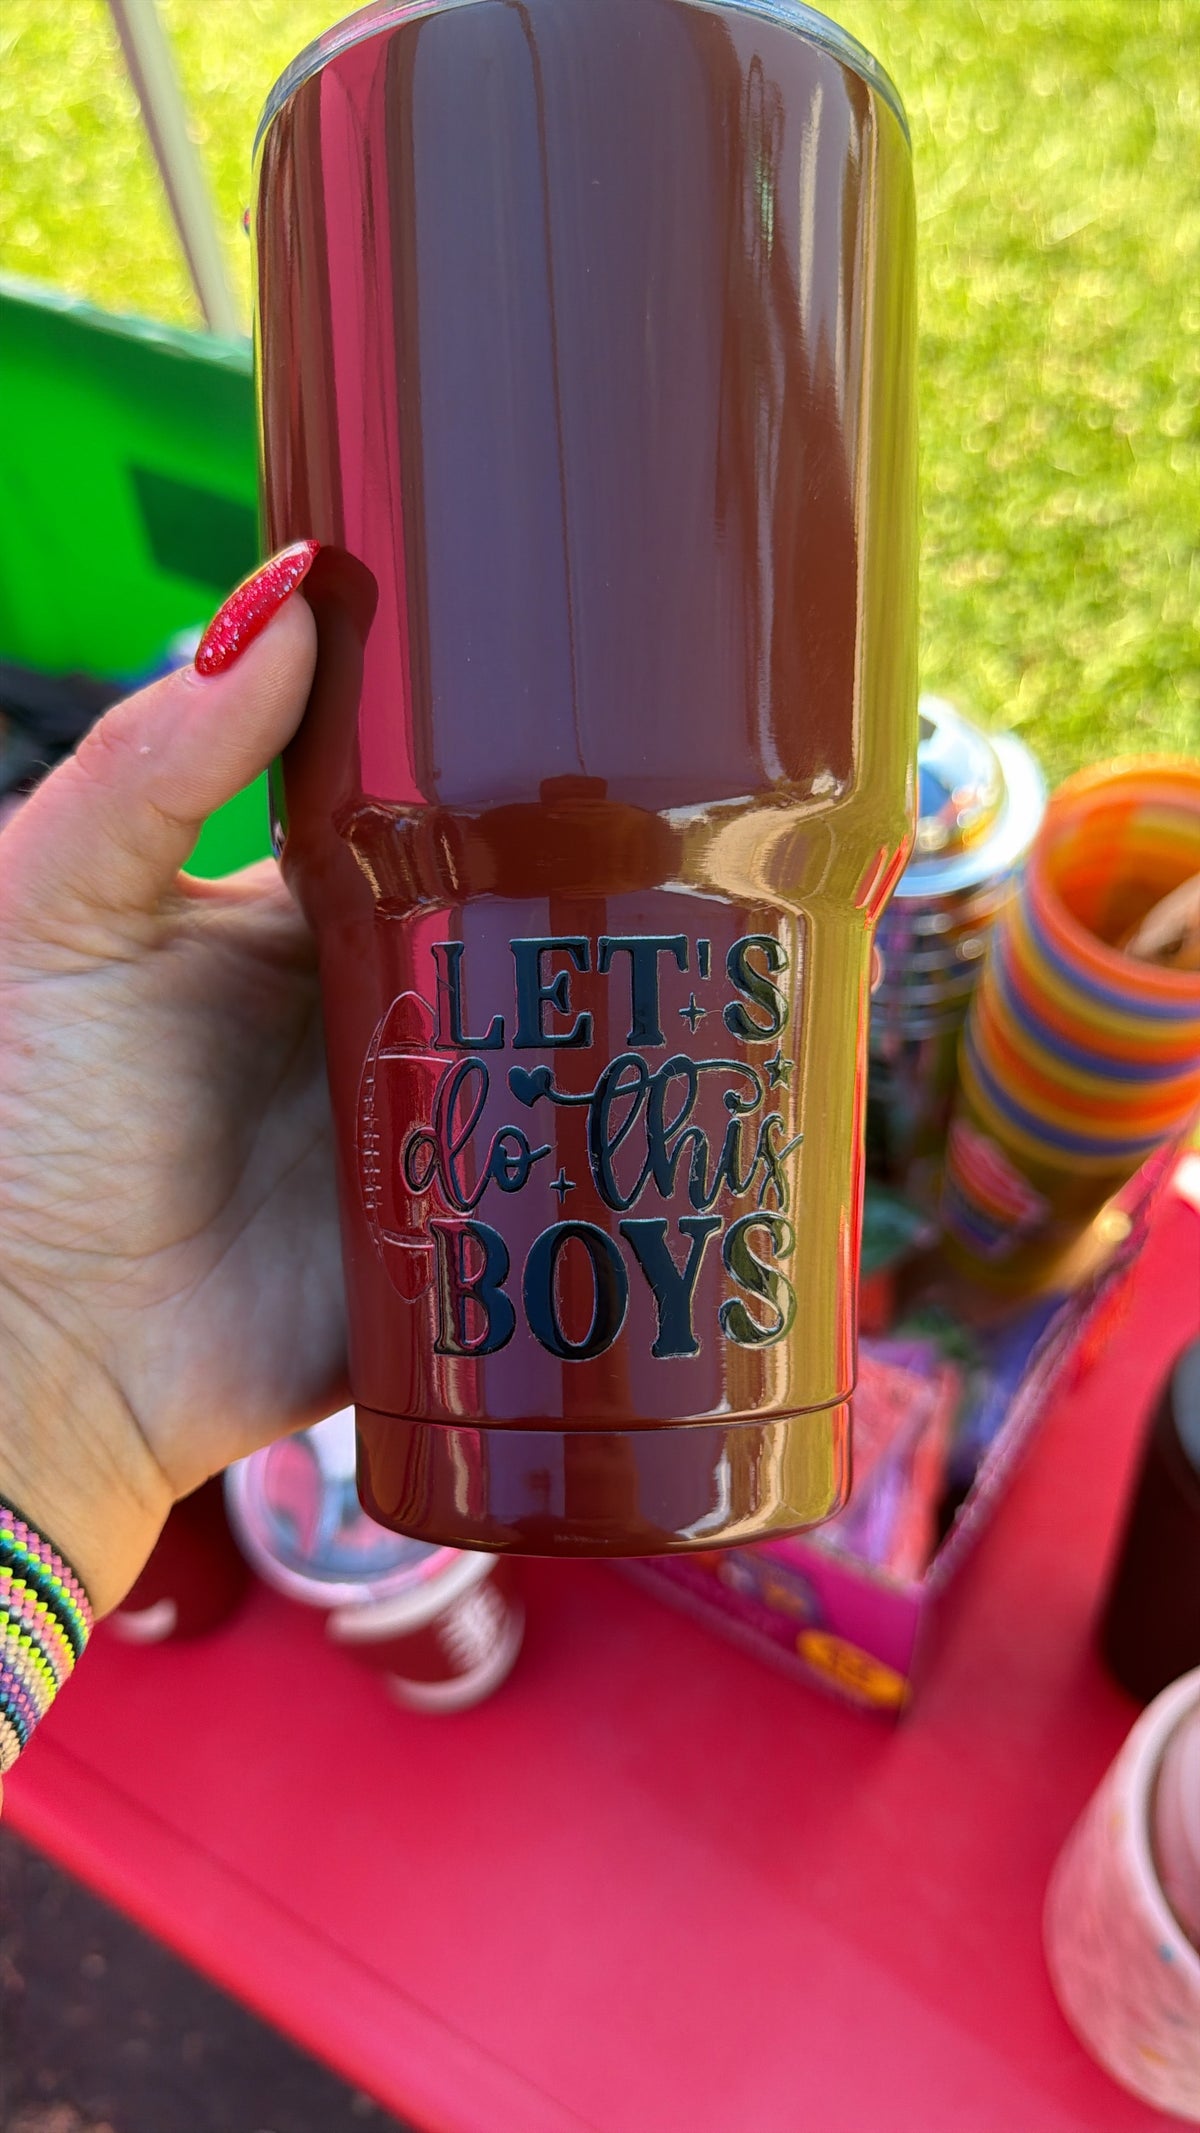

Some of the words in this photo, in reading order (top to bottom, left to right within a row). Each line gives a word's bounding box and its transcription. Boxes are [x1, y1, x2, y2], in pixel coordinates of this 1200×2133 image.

[431, 935, 790, 1050] LET'S
[401, 1056, 552, 1214] do
[540, 1052, 804, 1214] this
[428, 1213, 798, 1362] BOYS
